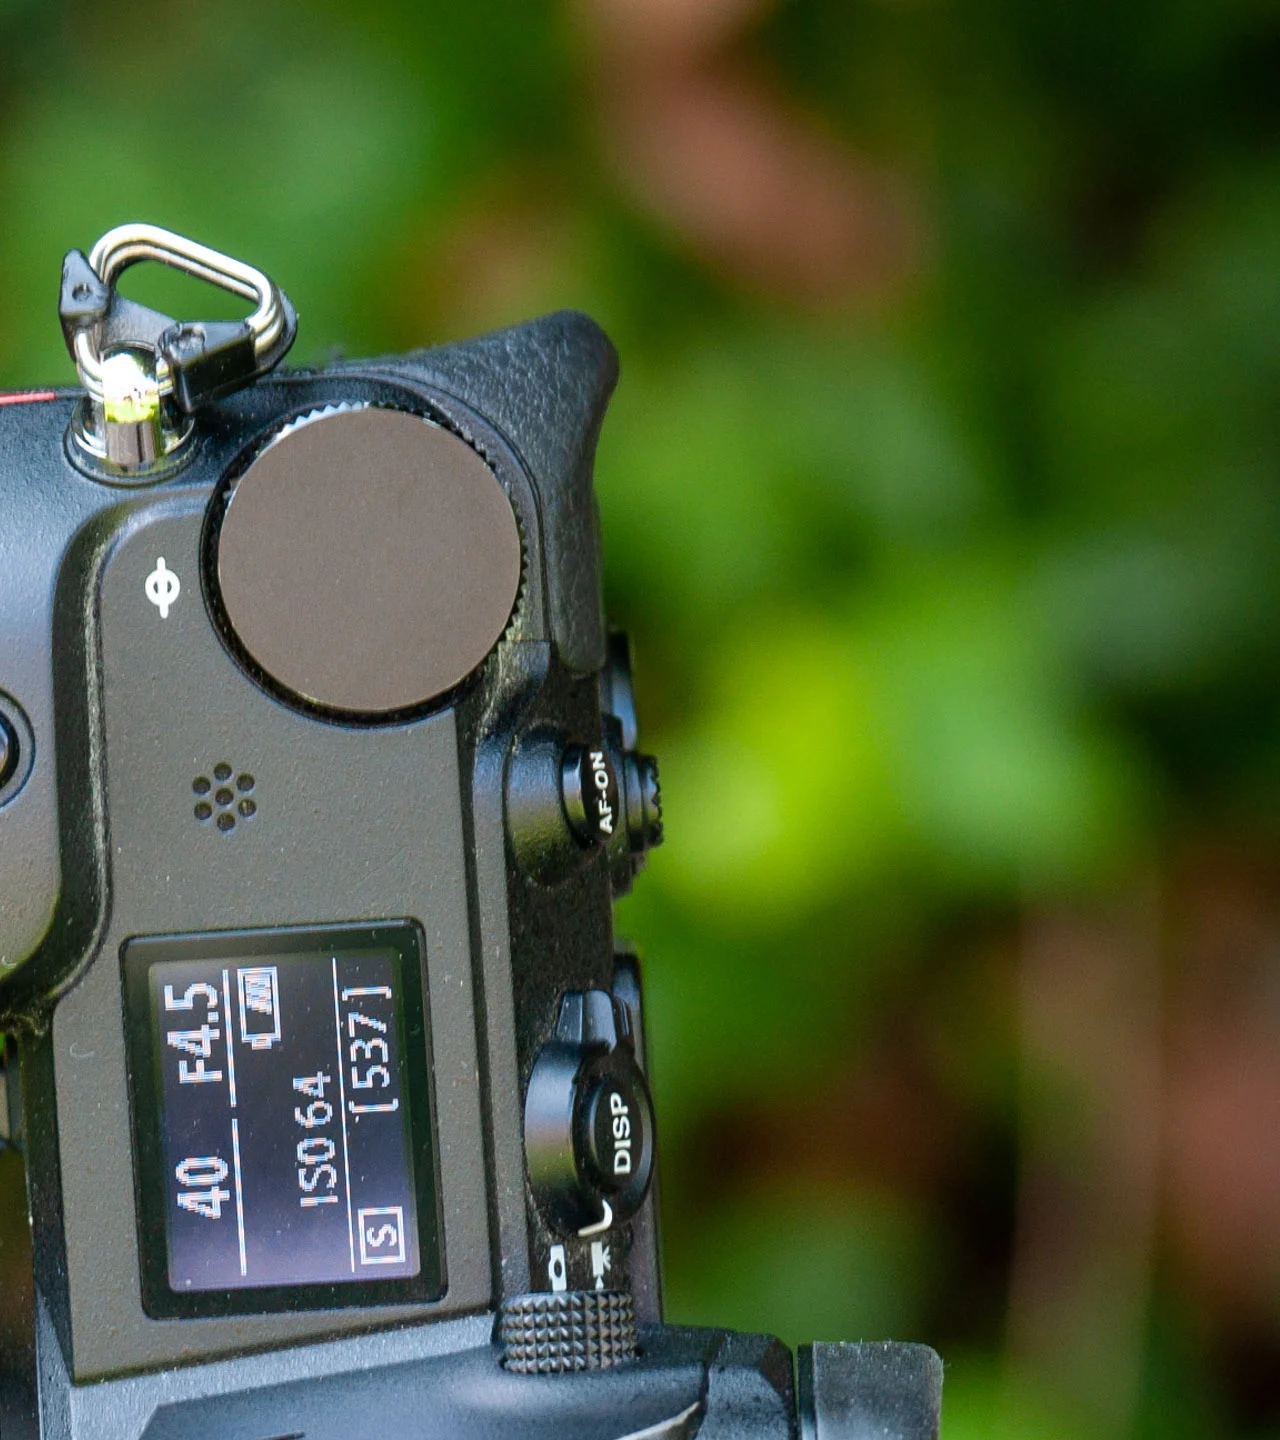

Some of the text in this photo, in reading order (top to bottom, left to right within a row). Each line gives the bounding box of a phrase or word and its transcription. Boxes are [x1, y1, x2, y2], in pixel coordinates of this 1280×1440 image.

[590, 752, 612, 833] AF-ON
[164, 982, 230, 1219] 40 F4.5
[293, 1072, 338, 1207] ISO 64
[611, 1093, 631, 1173] DISP
[366, 1222, 398, 1249] S
